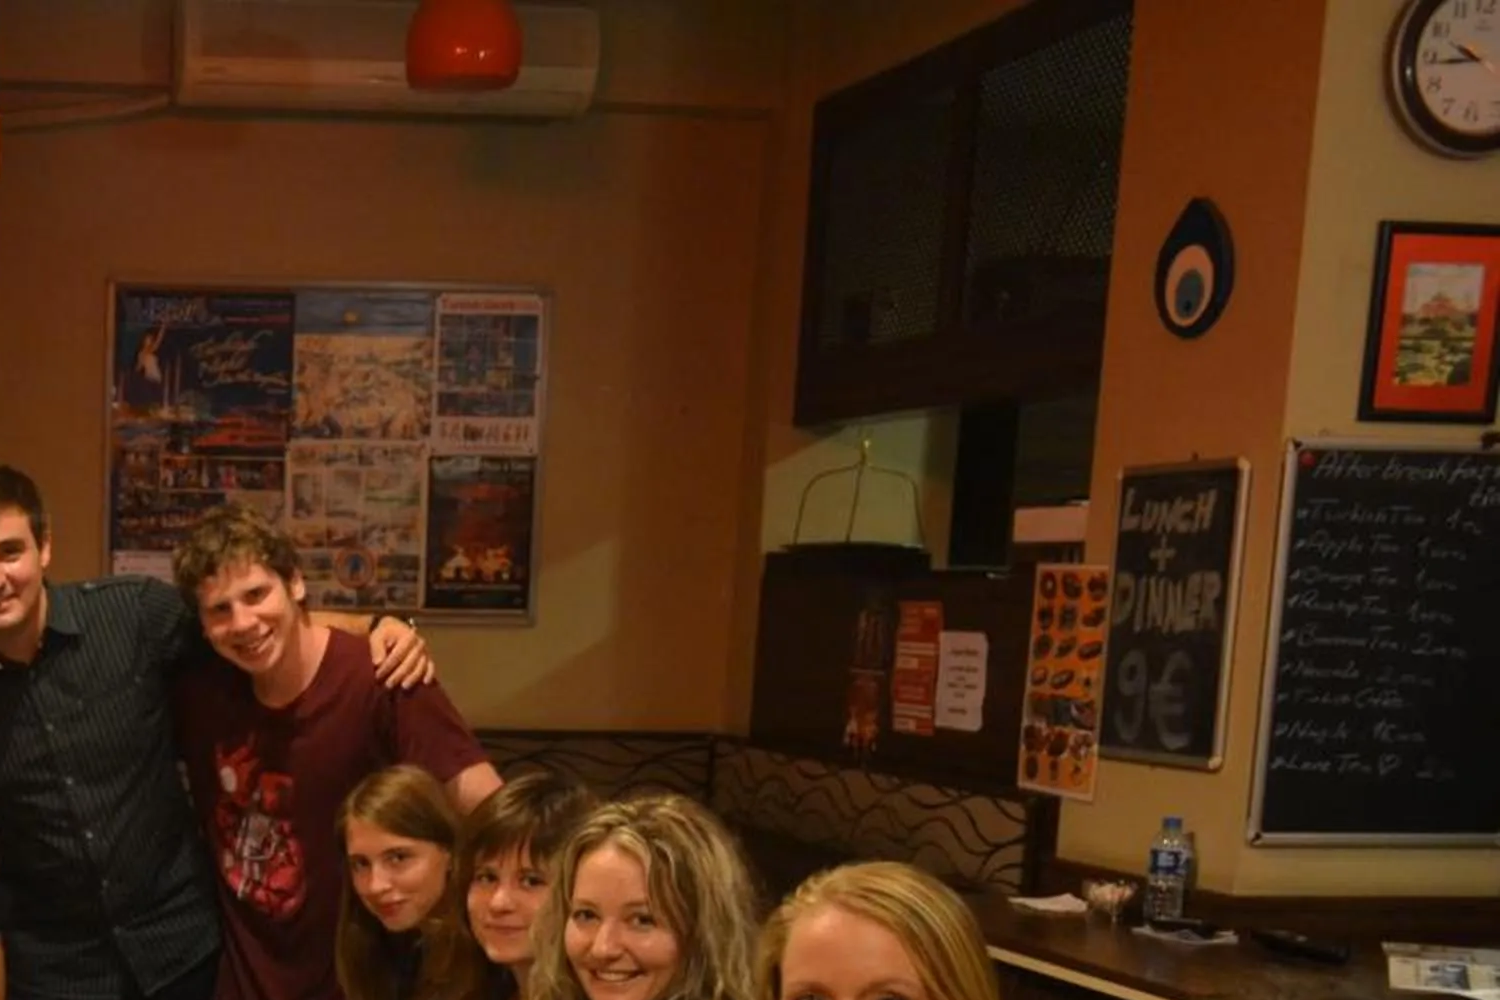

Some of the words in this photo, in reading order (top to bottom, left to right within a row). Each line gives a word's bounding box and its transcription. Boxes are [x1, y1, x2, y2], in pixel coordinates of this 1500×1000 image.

[1120, 487, 1217, 534] LUNCH
[1149, 535, 1177, 572] +
[1112, 570, 1222, 635] DINNER
